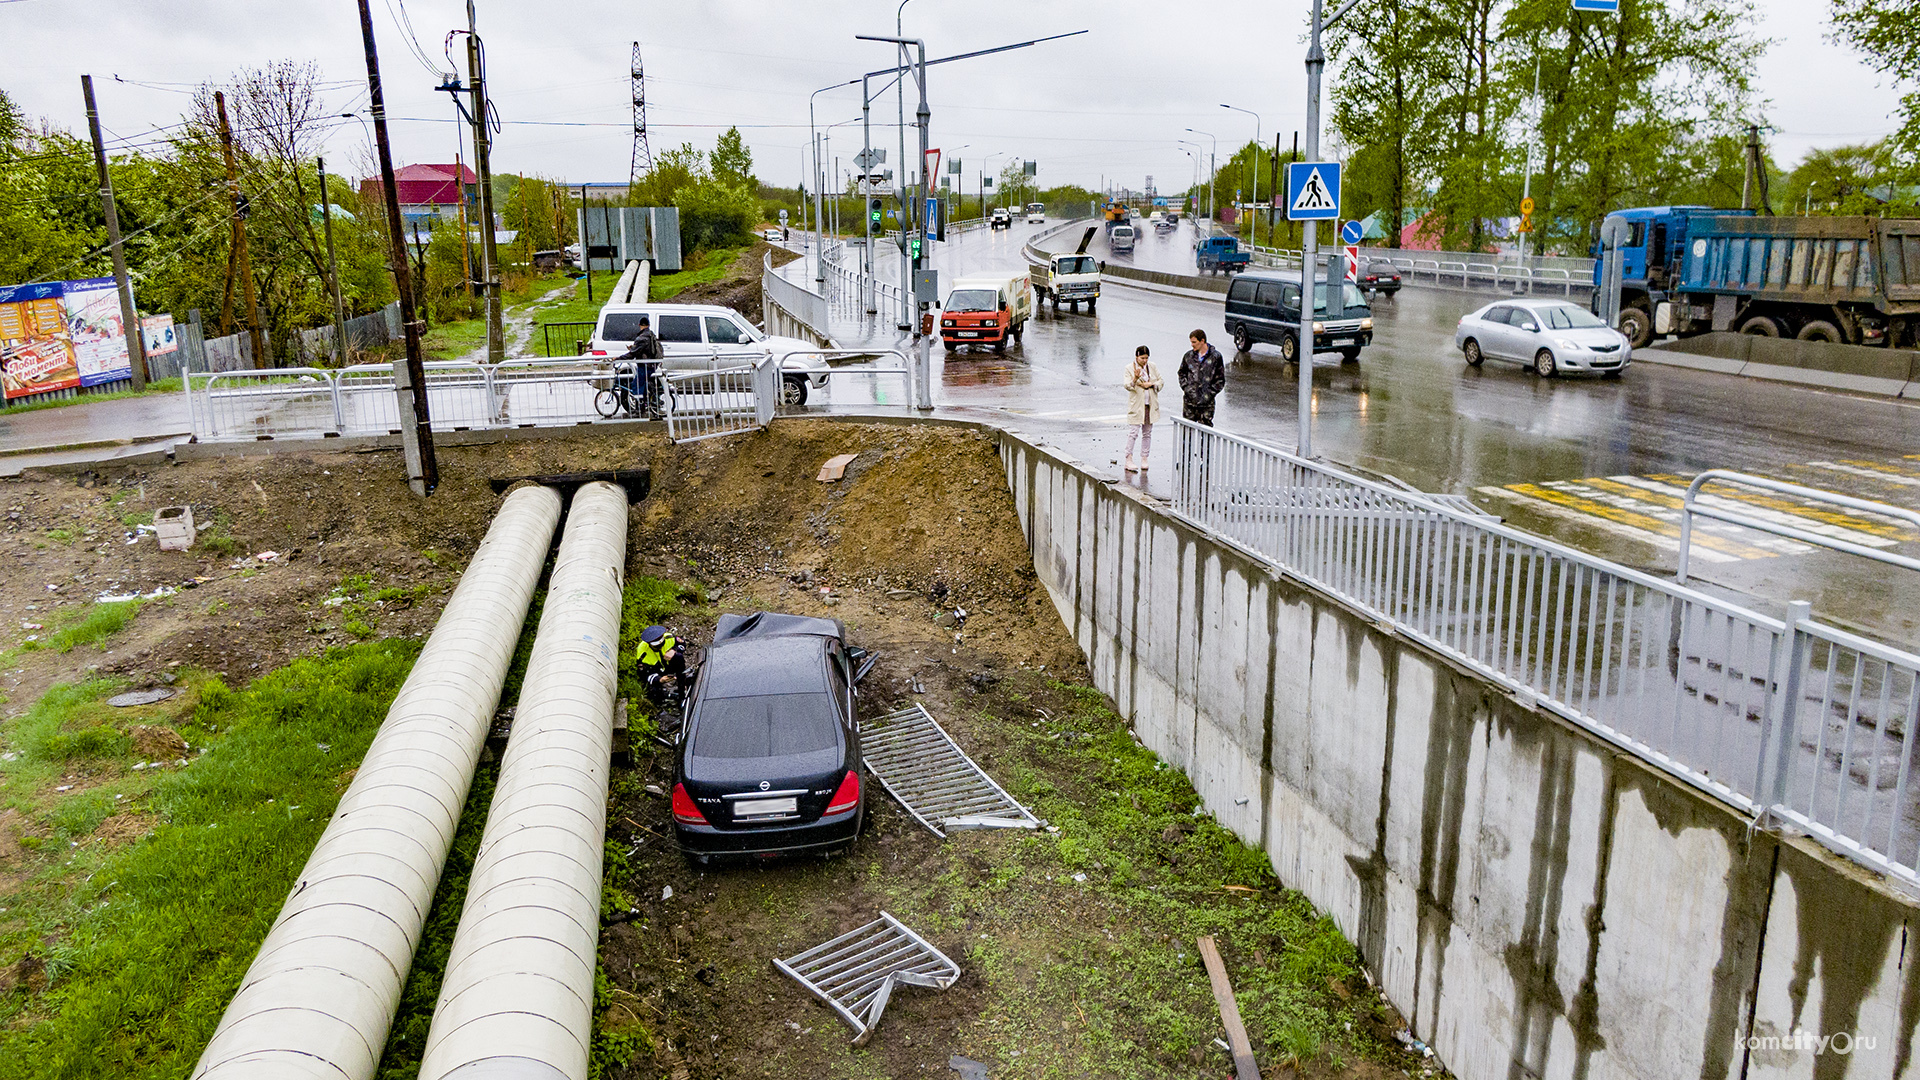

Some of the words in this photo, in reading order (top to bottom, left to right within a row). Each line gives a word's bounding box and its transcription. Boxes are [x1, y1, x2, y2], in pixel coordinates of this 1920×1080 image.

[1523, 202, 1532, 210] 40
[871, 212, 881, 221] 22
[9, 356, 36, 375] Лови
[23, 352, 67, 380] момент!
